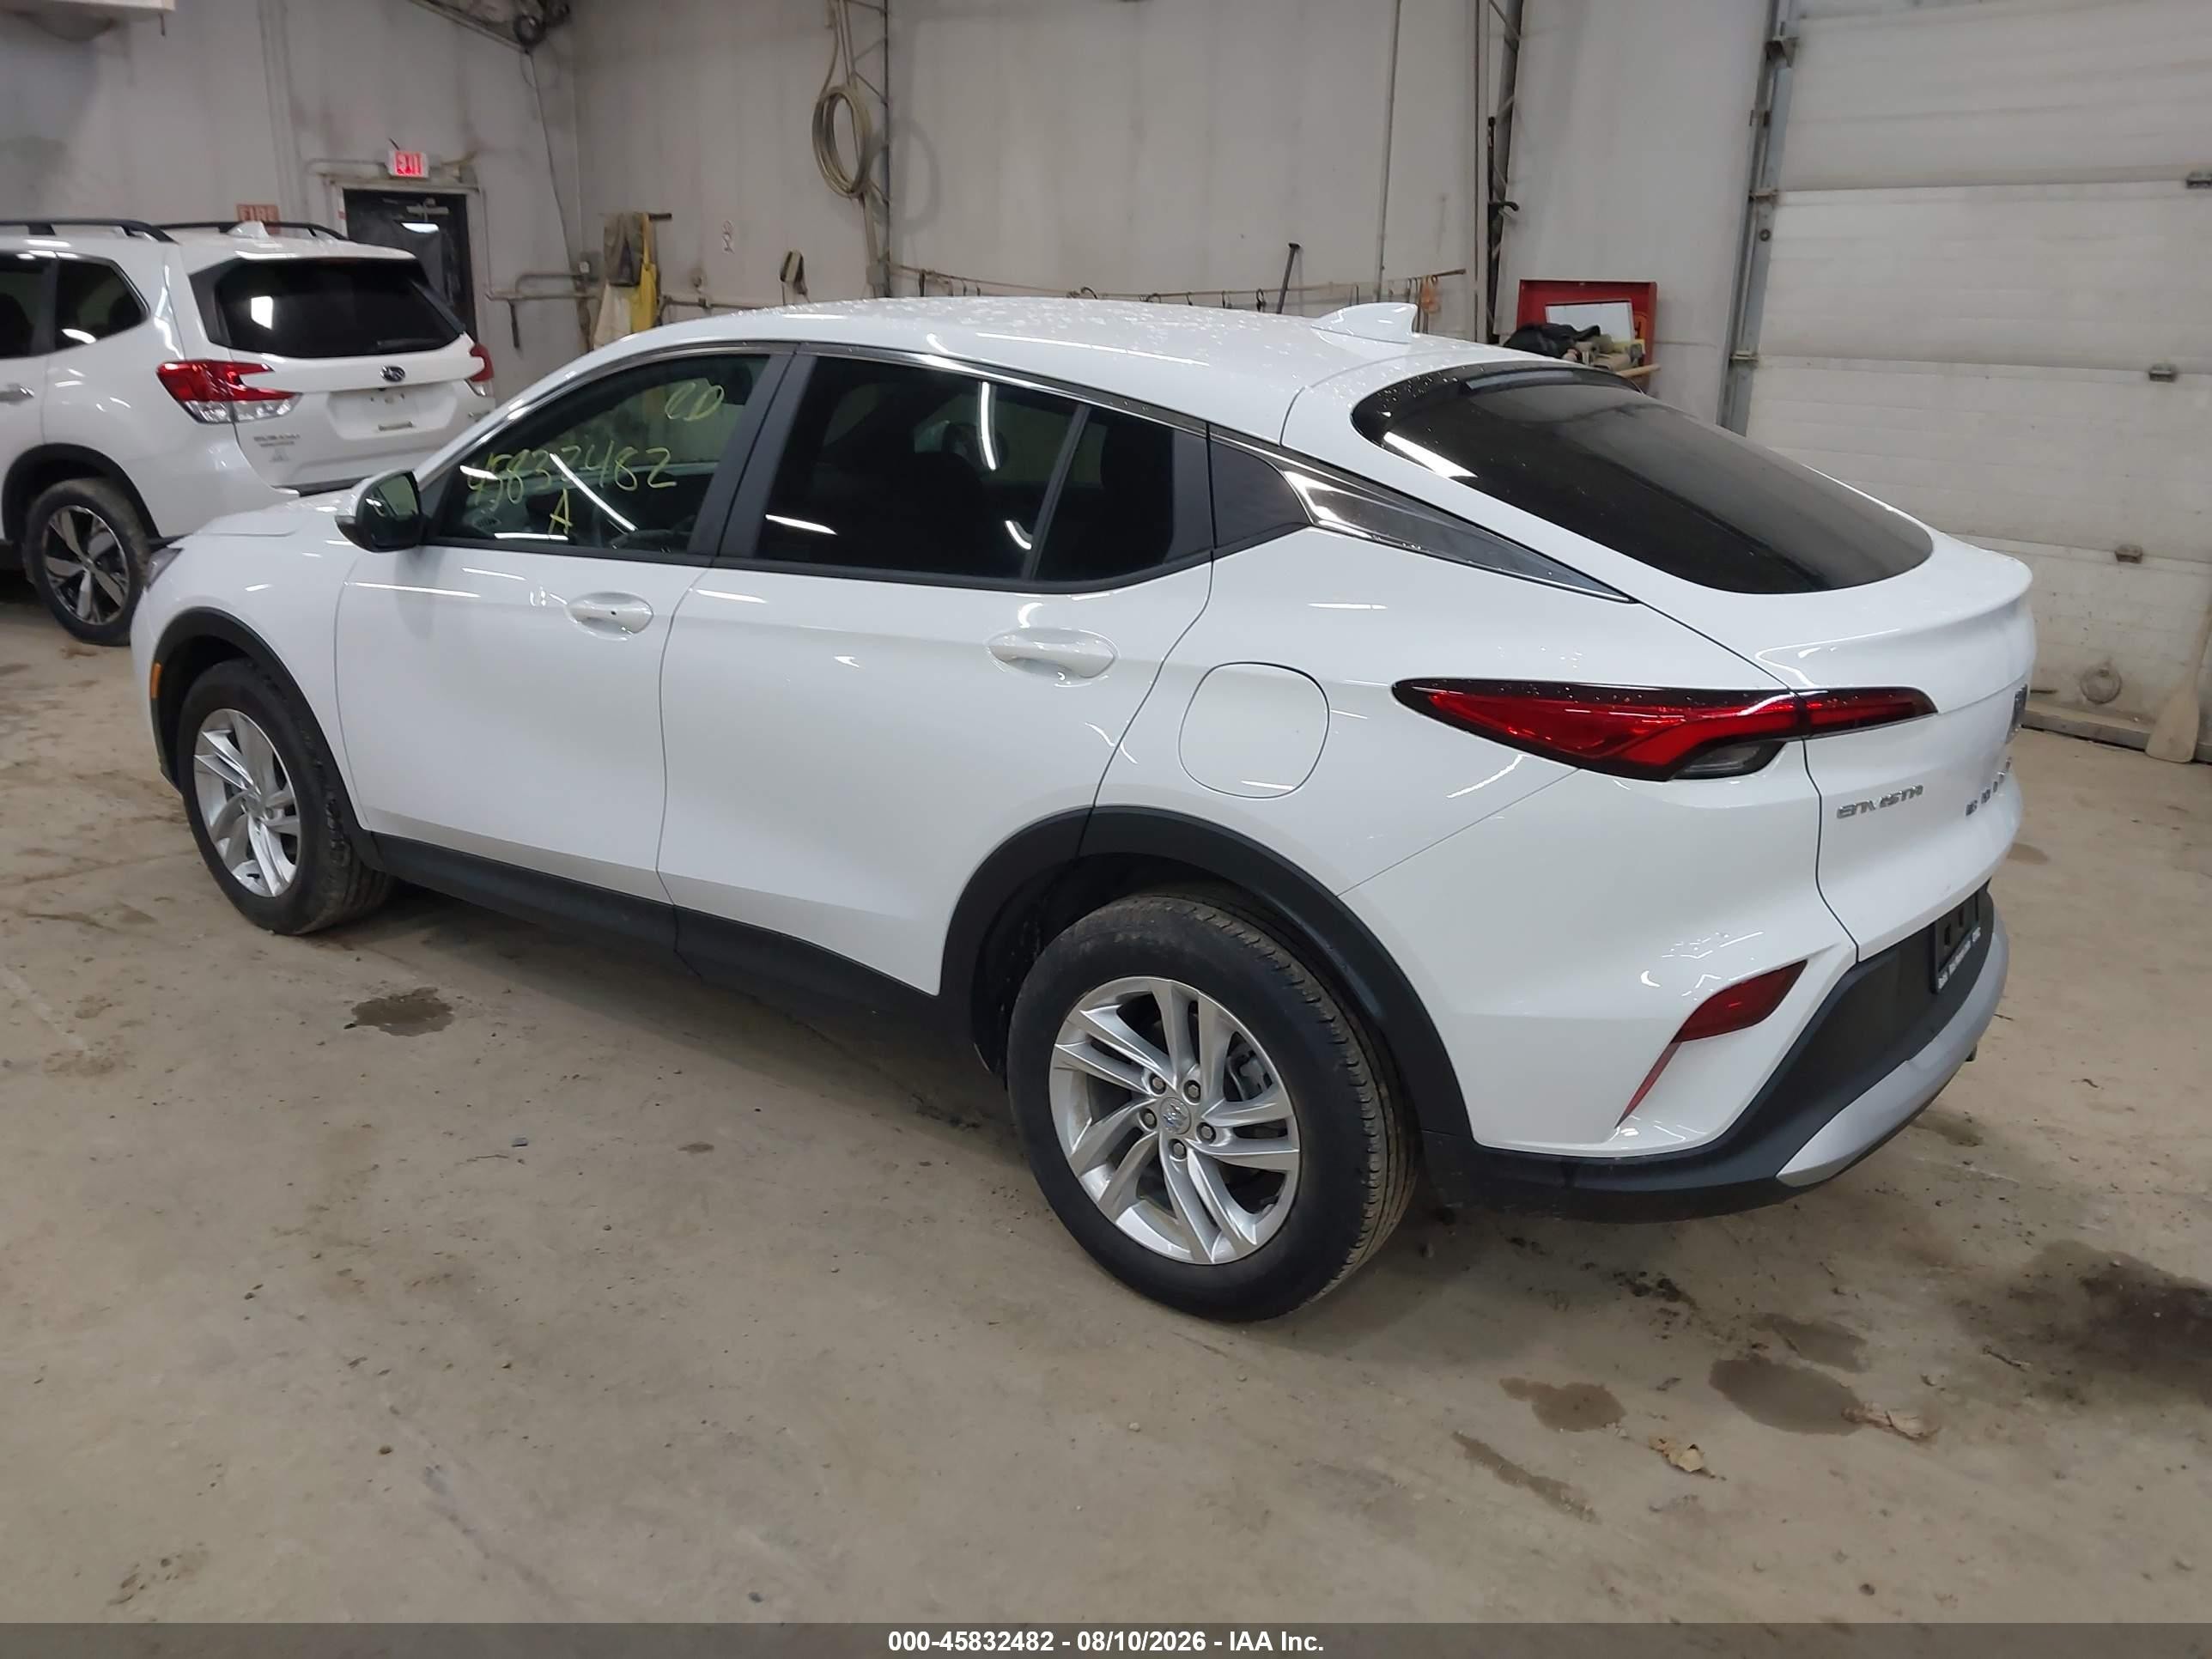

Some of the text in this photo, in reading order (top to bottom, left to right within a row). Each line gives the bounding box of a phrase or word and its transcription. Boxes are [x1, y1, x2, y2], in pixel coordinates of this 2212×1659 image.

[395, 153, 422, 175] EXIT
[549, 487, 574, 535] A
[1837, 784, 1923, 819] ENVISTA
